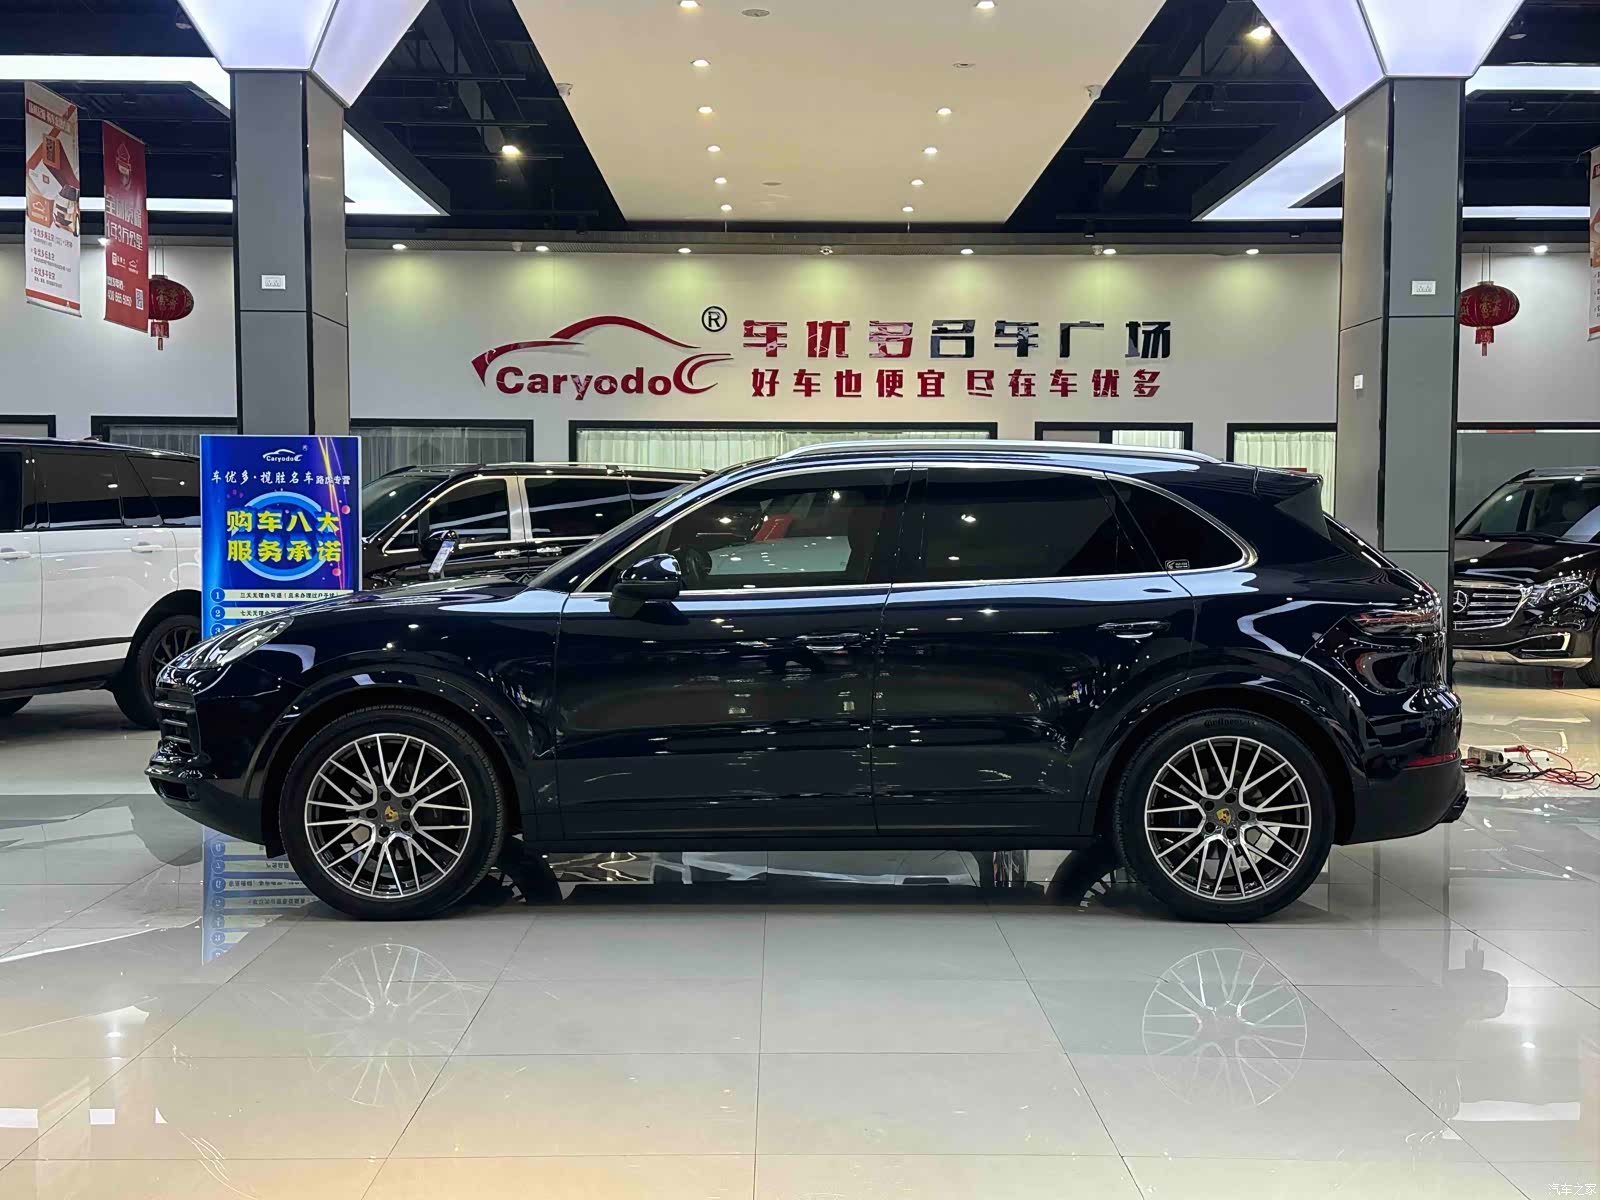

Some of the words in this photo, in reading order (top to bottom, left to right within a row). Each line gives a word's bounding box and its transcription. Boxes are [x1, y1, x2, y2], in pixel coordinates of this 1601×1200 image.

[743, 319, 1171, 358] 车优多名车广场
[752, 368, 945, 398] 好车也便宜
[966, 368, 1161, 398] 尽在车优多
[226, 510, 339, 533] 购车八大
[227, 539, 342, 563] 服务承诺
